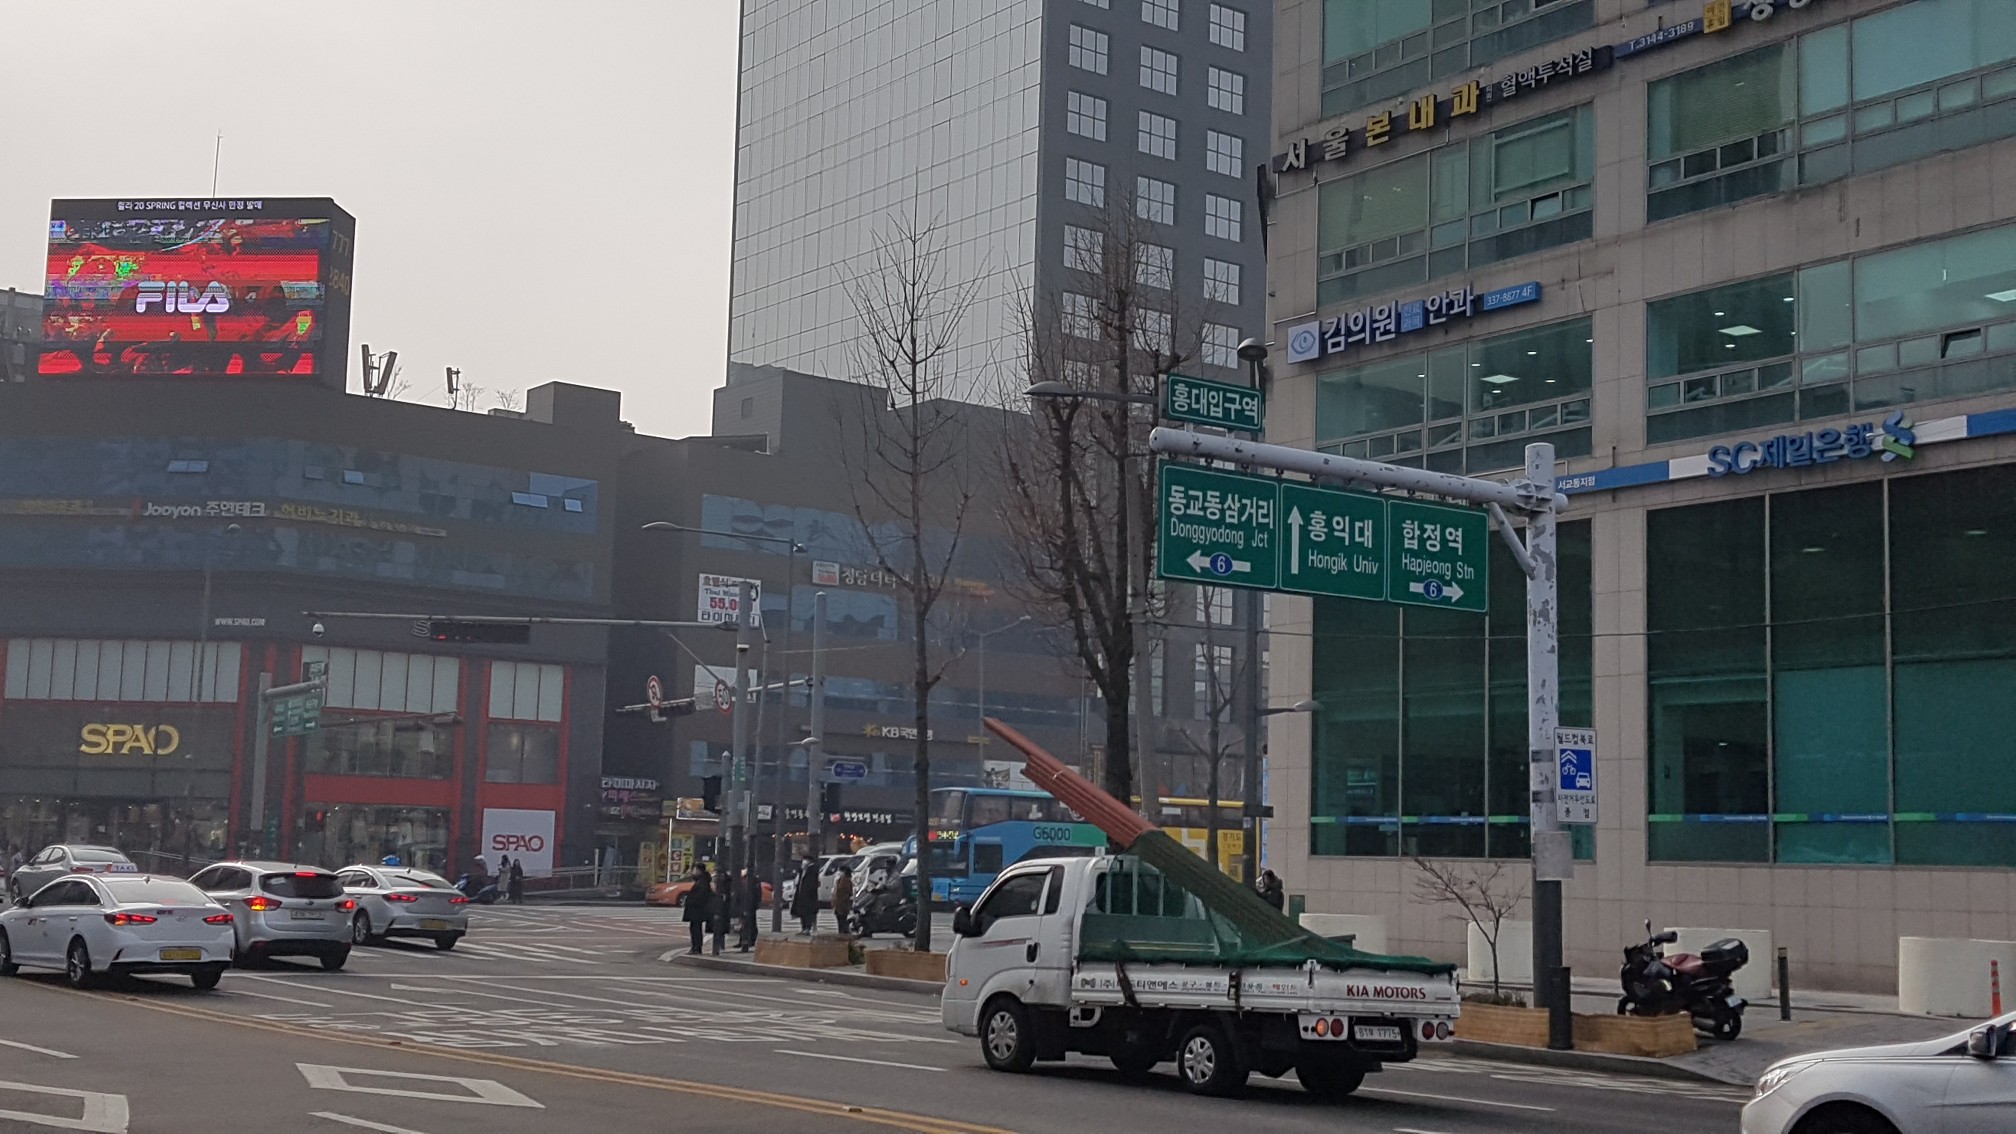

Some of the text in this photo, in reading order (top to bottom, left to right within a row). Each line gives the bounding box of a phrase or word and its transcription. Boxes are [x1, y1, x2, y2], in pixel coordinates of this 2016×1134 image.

[1629, 21, 1694, 50] T.3144-3189
[1501, 47, 1593, 97] 혈액투석실
[134, 201, 144, 210] 20
[146, 201, 176, 210] SPRING
[136, 281, 230, 313] FILA
[1324, 284, 1534, 354] 김의원 안과 337-8877 4F
[1172, 383, 1258, 424] 홍대입구역
[1707, 423, 1874, 478] SC제일은행
[1558, 476, 1595, 490] 서교동지점
[144, 501, 266, 519] Jooyon 주연테크
[1169, 485, 1273, 529] 동교동삼거리
[1170, 522, 1268, 548] Donggyodong Jct
[1308, 511, 1373, 548] 홍익대
[1402, 520, 1462, 555] 합정역
[1217, 557, 1225, 572] 6
[1308, 550, 1378, 574] Hongik Univ
[1402, 554, 1474, 579] Hapjeong Stn
[1429, 583, 1437, 596] 6
[710, 597, 739, 611] 55,0
[80, 723, 180, 755] SPAO
[882, 726, 933, 740] KB국민행
[1556, 732, 1594, 745] 월드컵북로
[491, 834, 544, 853] SPAO
[1033, 826, 1071, 841] G6000
[1346, 985, 1426, 1000] KIA MOTORS
